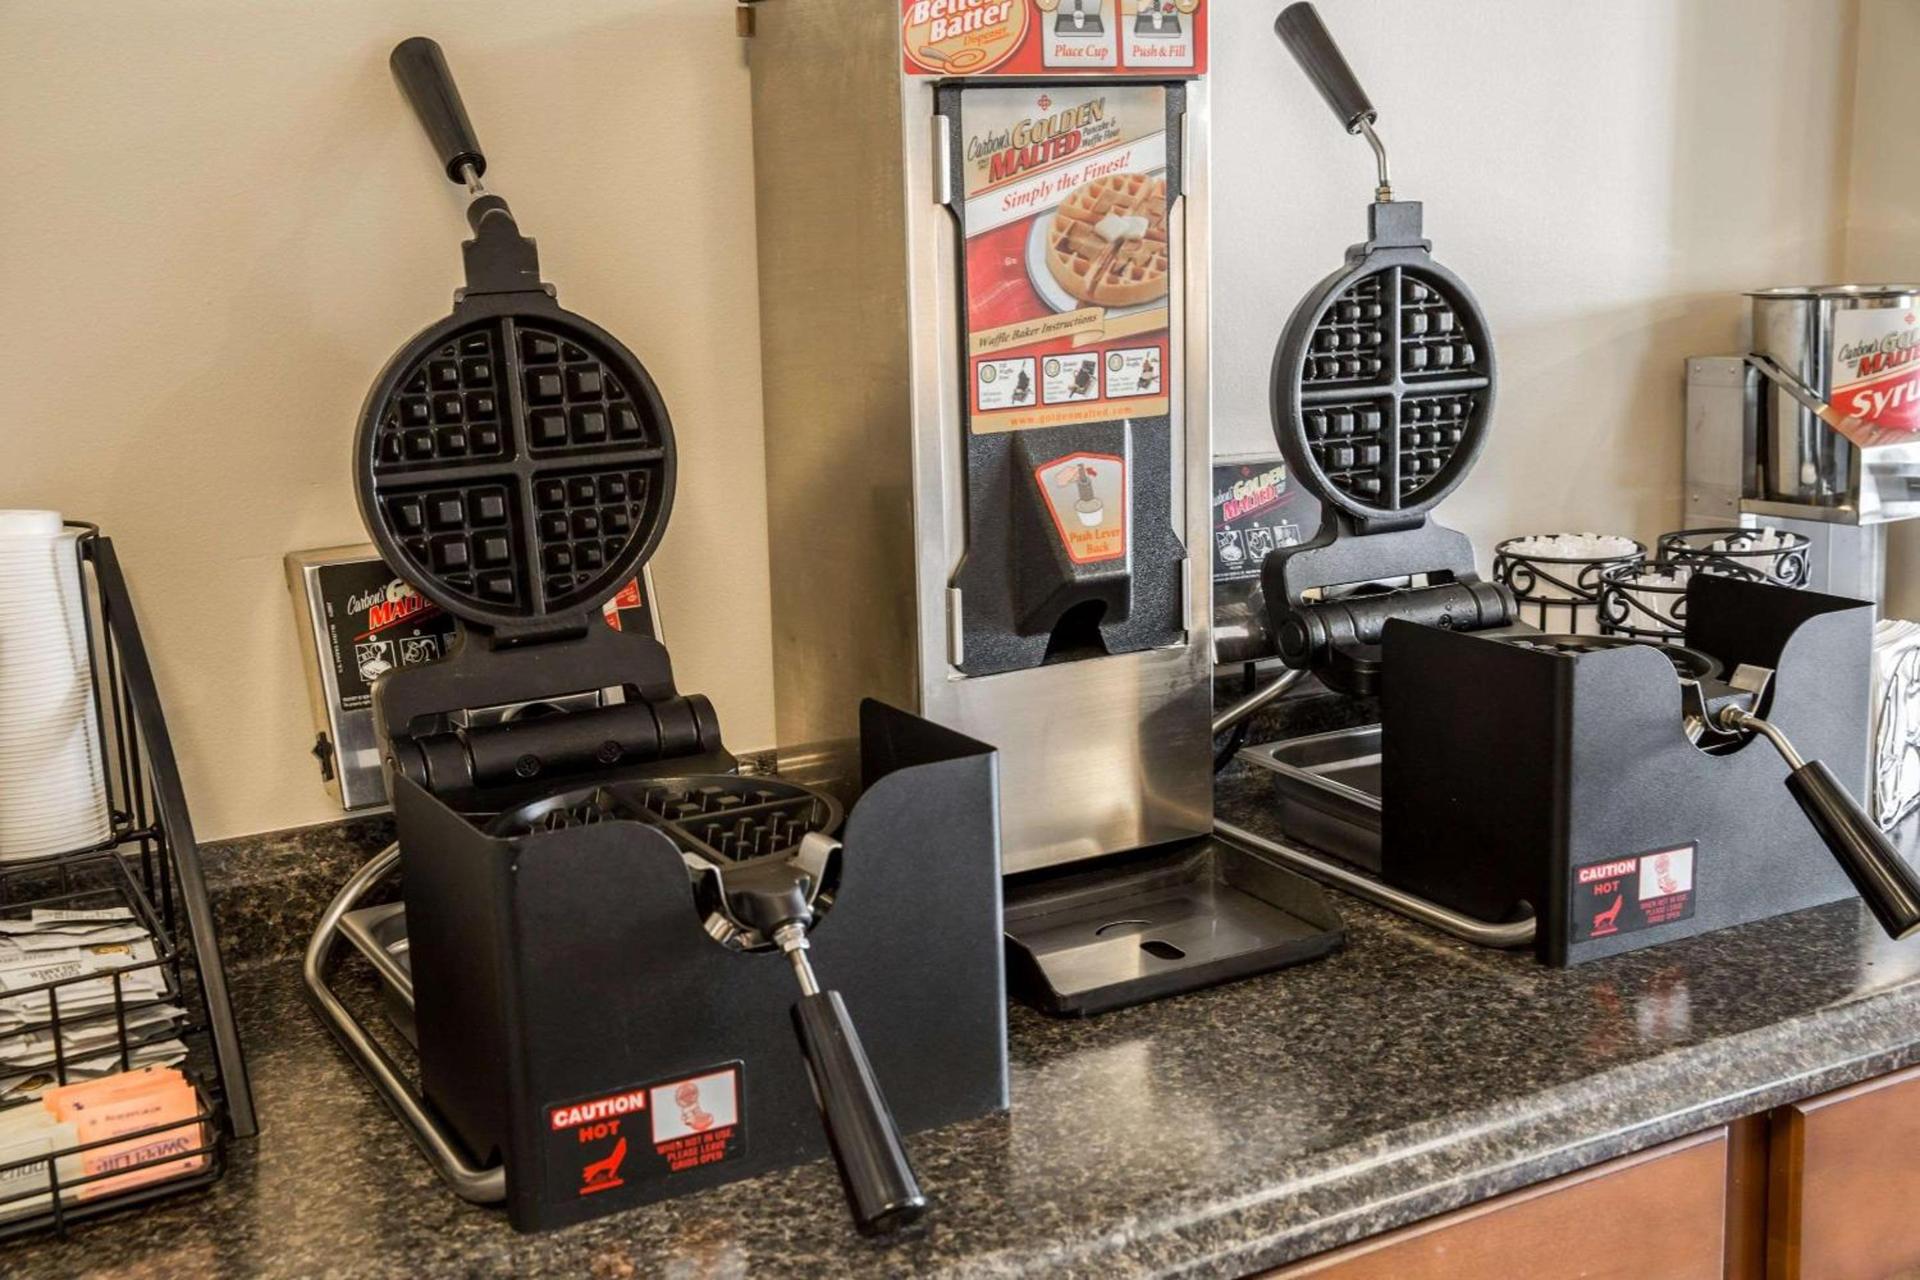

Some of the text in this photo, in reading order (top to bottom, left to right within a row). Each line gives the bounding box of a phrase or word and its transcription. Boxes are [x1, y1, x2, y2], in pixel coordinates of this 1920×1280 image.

[928, 0, 1013, 45] Batter
[1054, 44, 1109, 61] Place Cup
[1132, 44, 1157, 57] Push
[1169, 44, 1186, 57] Fill
[1012, 97, 1106, 150] GOLDEN
[988, 128, 1082, 183] MALTED
[1002, 151, 1131, 212] Simply the Finest!
[979, 314, 1097, 348] Waffle Baker Instructions
[1223, 485, 1279, 522] MALTED
[1070, 528, 1121, 543] Push Lever
[1086, 541, 1110, 553] Back
[347, 585, 387, 616] Carbon's
[1579, 861, 1637, 883] CAUTION
[1593, 880, 1620, 895] HOT
[552, 1092, 646, 1128] CAUTION
[579, 1120, 621, 1144] HOT
[667, 1147, 698, 1163] PLEASE
